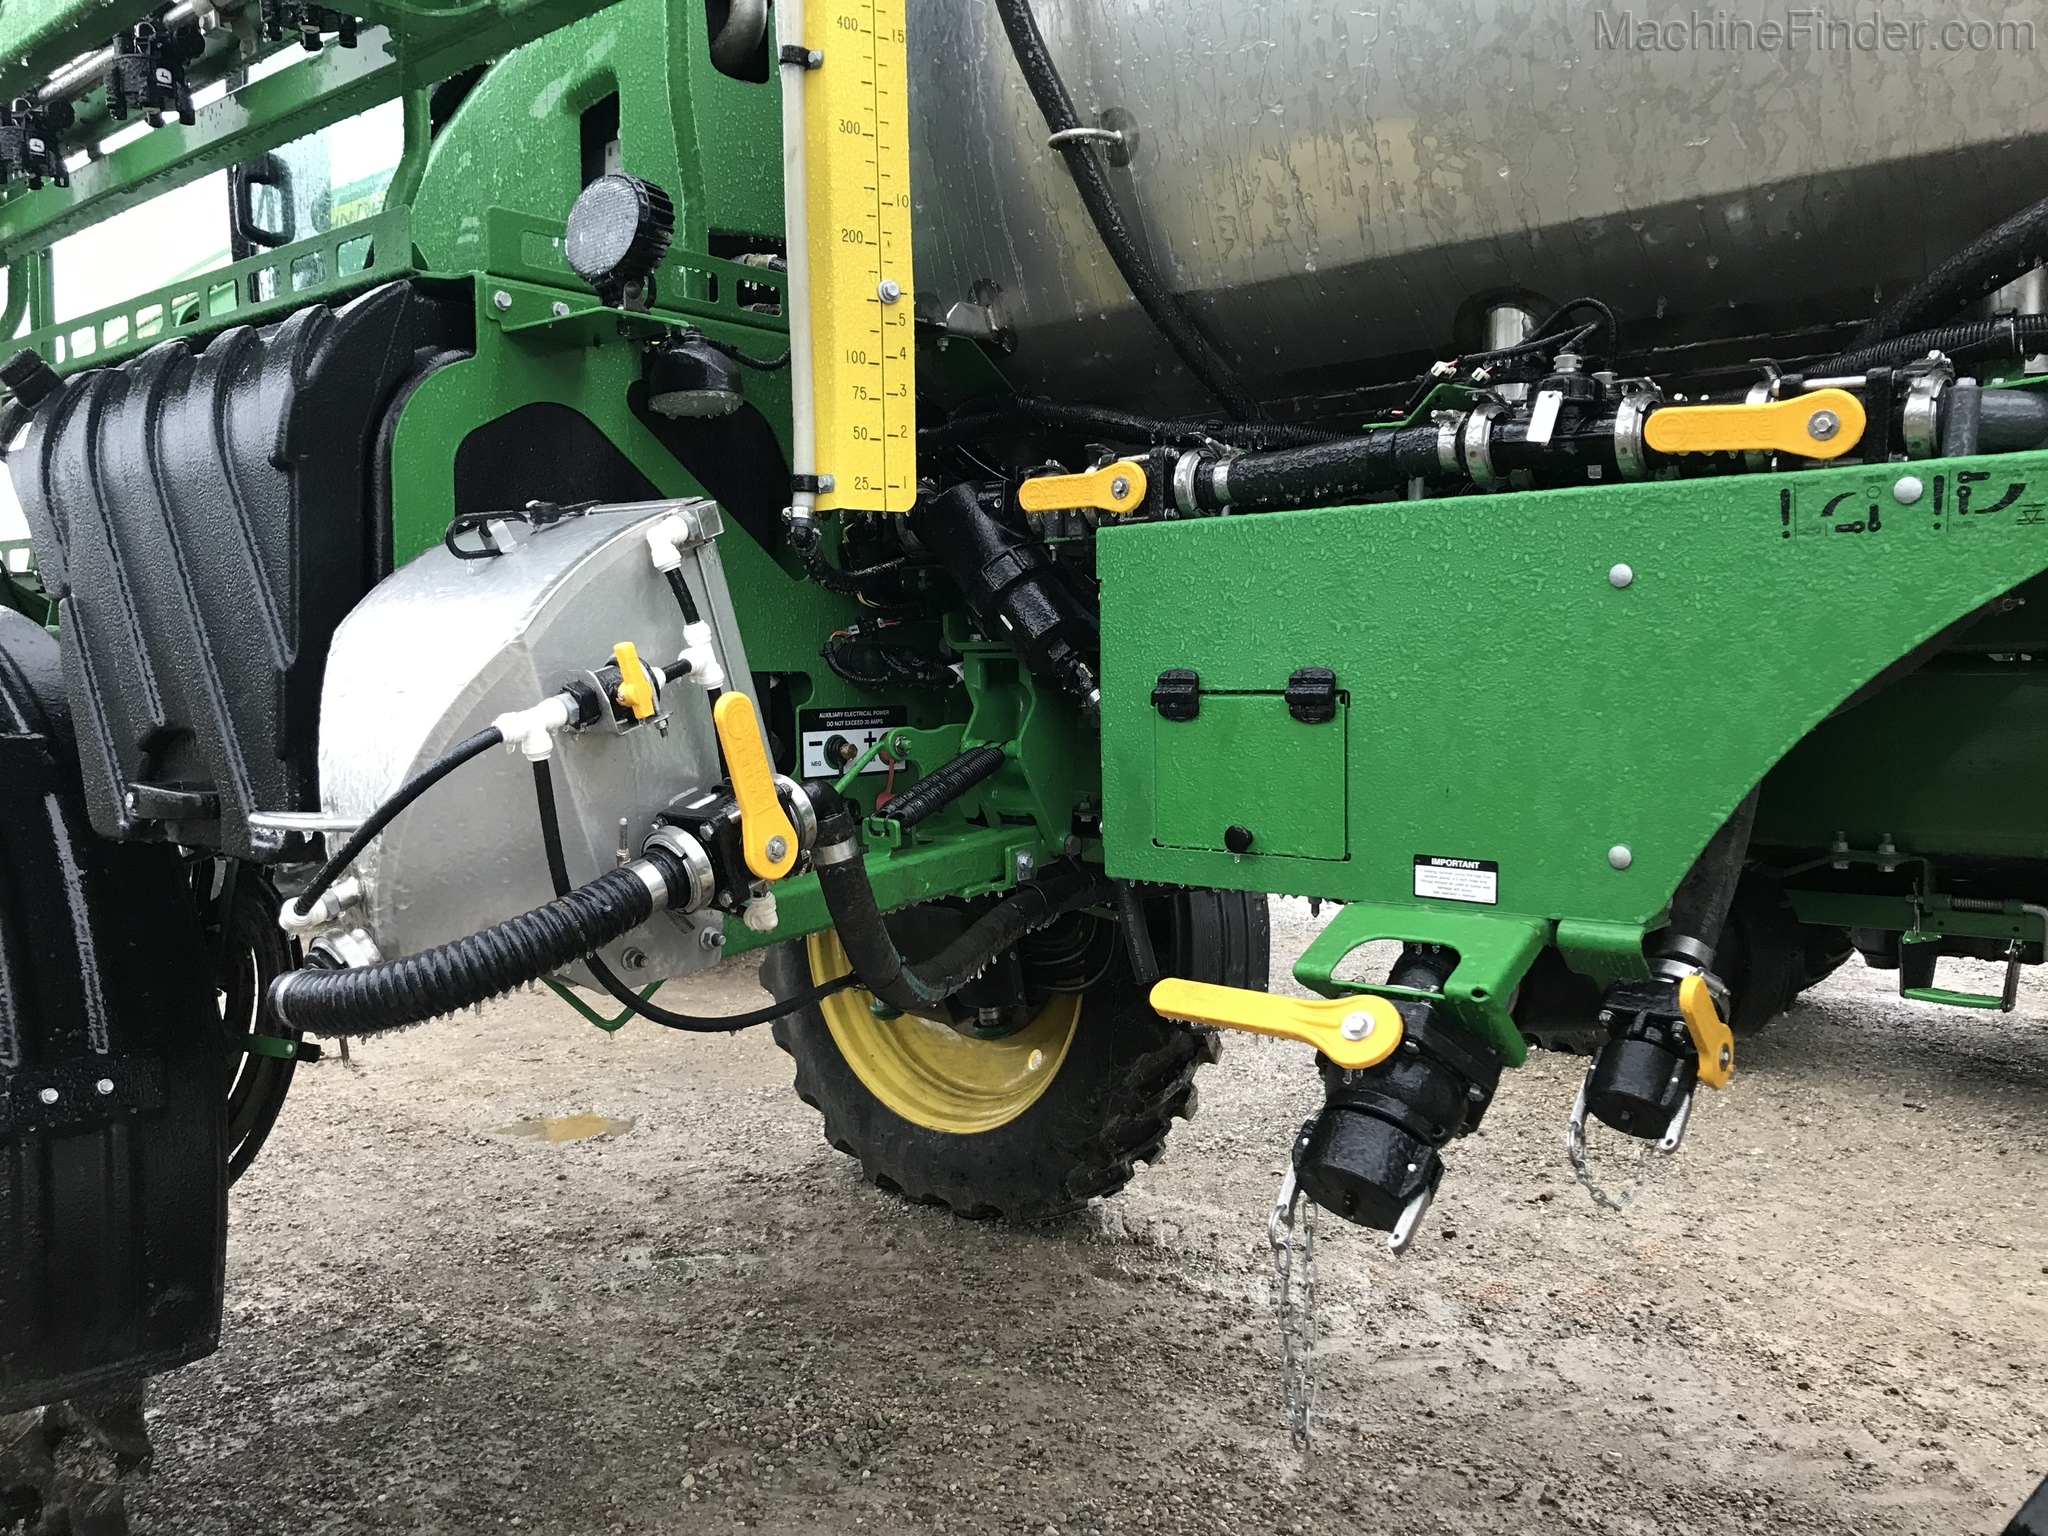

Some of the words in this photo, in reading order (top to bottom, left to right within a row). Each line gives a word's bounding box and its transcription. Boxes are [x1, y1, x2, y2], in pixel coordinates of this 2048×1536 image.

[836, 15, 858, 31] 400
[892, 29, 905, 44] 15
[838, 119, 861, 135] 300
[895, 194, 909, 208] 10
[841, 228, 863, 244] 200
[898, 312, 906, 327] 5
[845, 350, 866, 365] 100
[899, 346, 907, 361] 4
[852, 385, 867, 401] 75
[899, 383, 907, 397] 3
[853, 427, 868, 441] 50
[900, 425, 908, 439] 2
[854, 476, 869, 491] 25
[844, 710, 873, 718] ELECTRICAL
[1431, 857, 1480, 869] IMPORTANT
